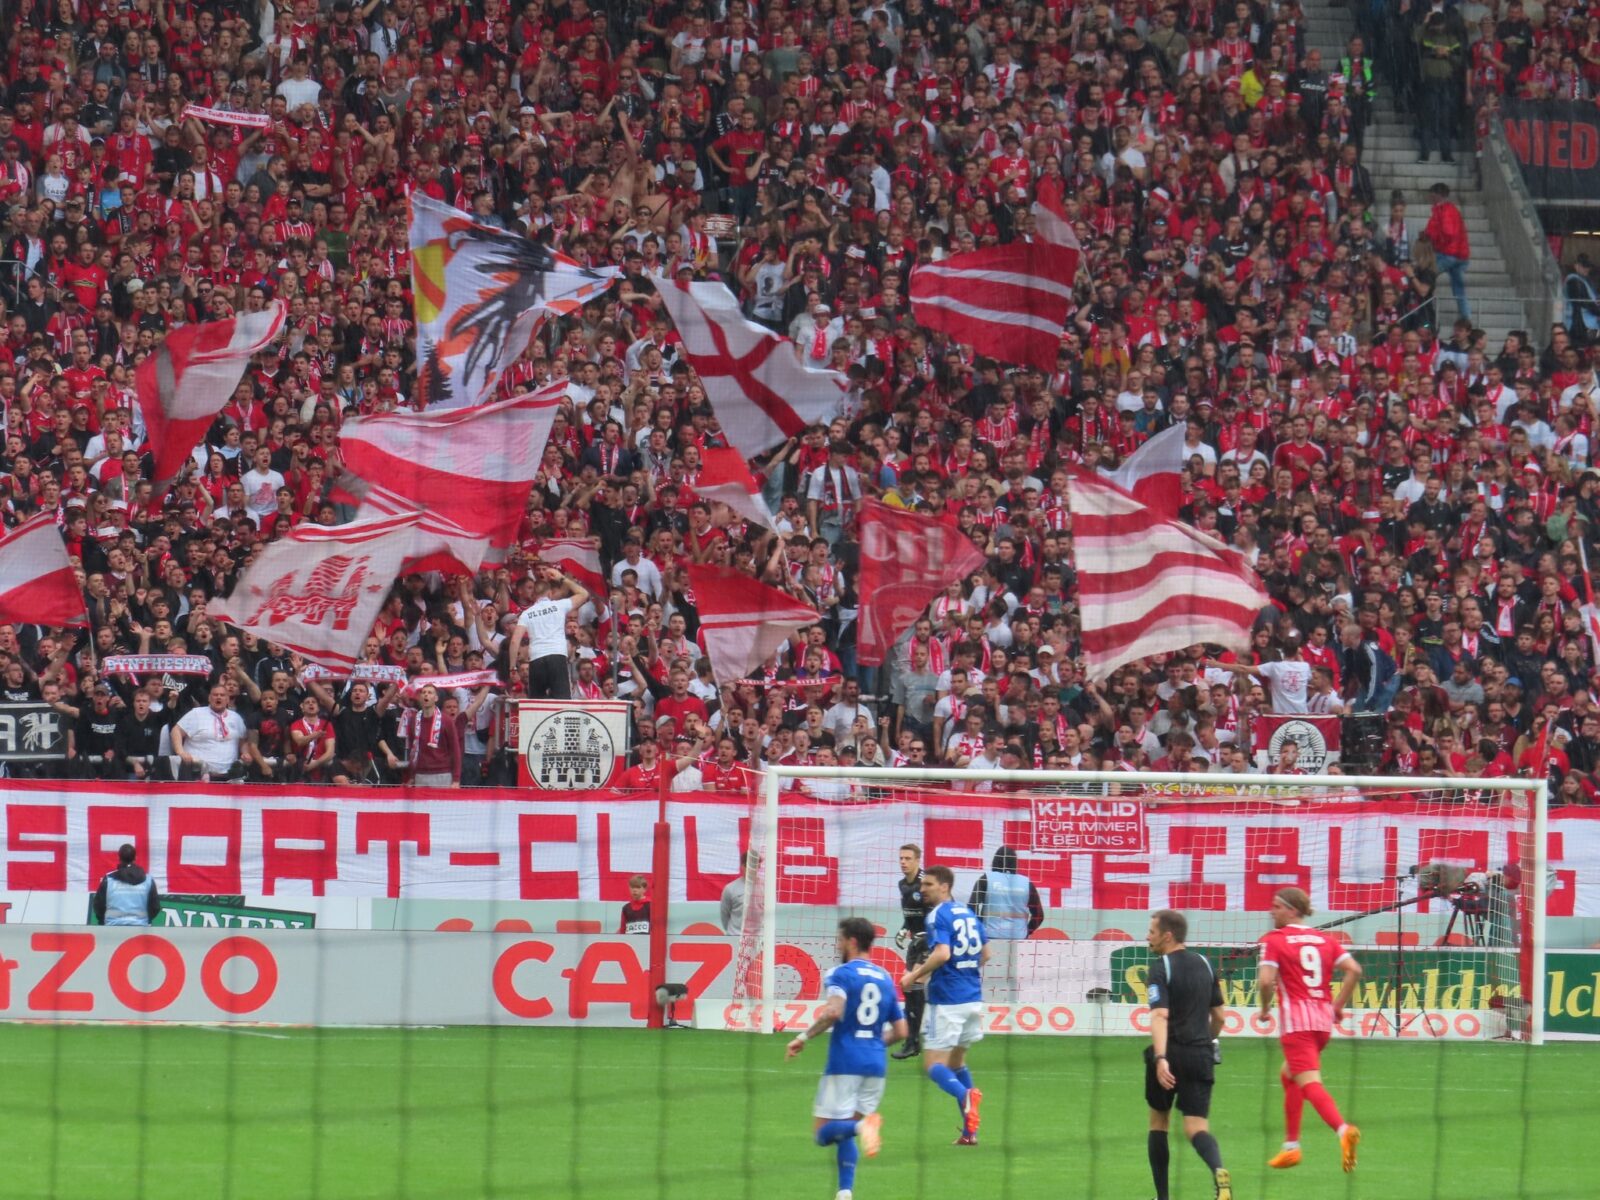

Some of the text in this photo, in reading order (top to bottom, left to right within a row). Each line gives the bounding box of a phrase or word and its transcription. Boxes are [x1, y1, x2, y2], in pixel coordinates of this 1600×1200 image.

[527, 605, 558, 619] ULTRAS
[543, 761, 600, 769] SYNTHESIA
[1037, 801, 1137, 817] KHALID
[1038, 817, 1138, 832] FÜR IMMER
[1052, 835, 1124, 846] BEI UNS
[7, 805, 1578, 917] SPORT-CLUB FREIBURG
[953, 918, 983, 956] 35
[0, 932, 278, 1013] ZOO
[1300, 945, 1323, 987] 9
[857, 982, 882, 1026] 8
[1334, 1011, 1481, 1038] CAZOO
